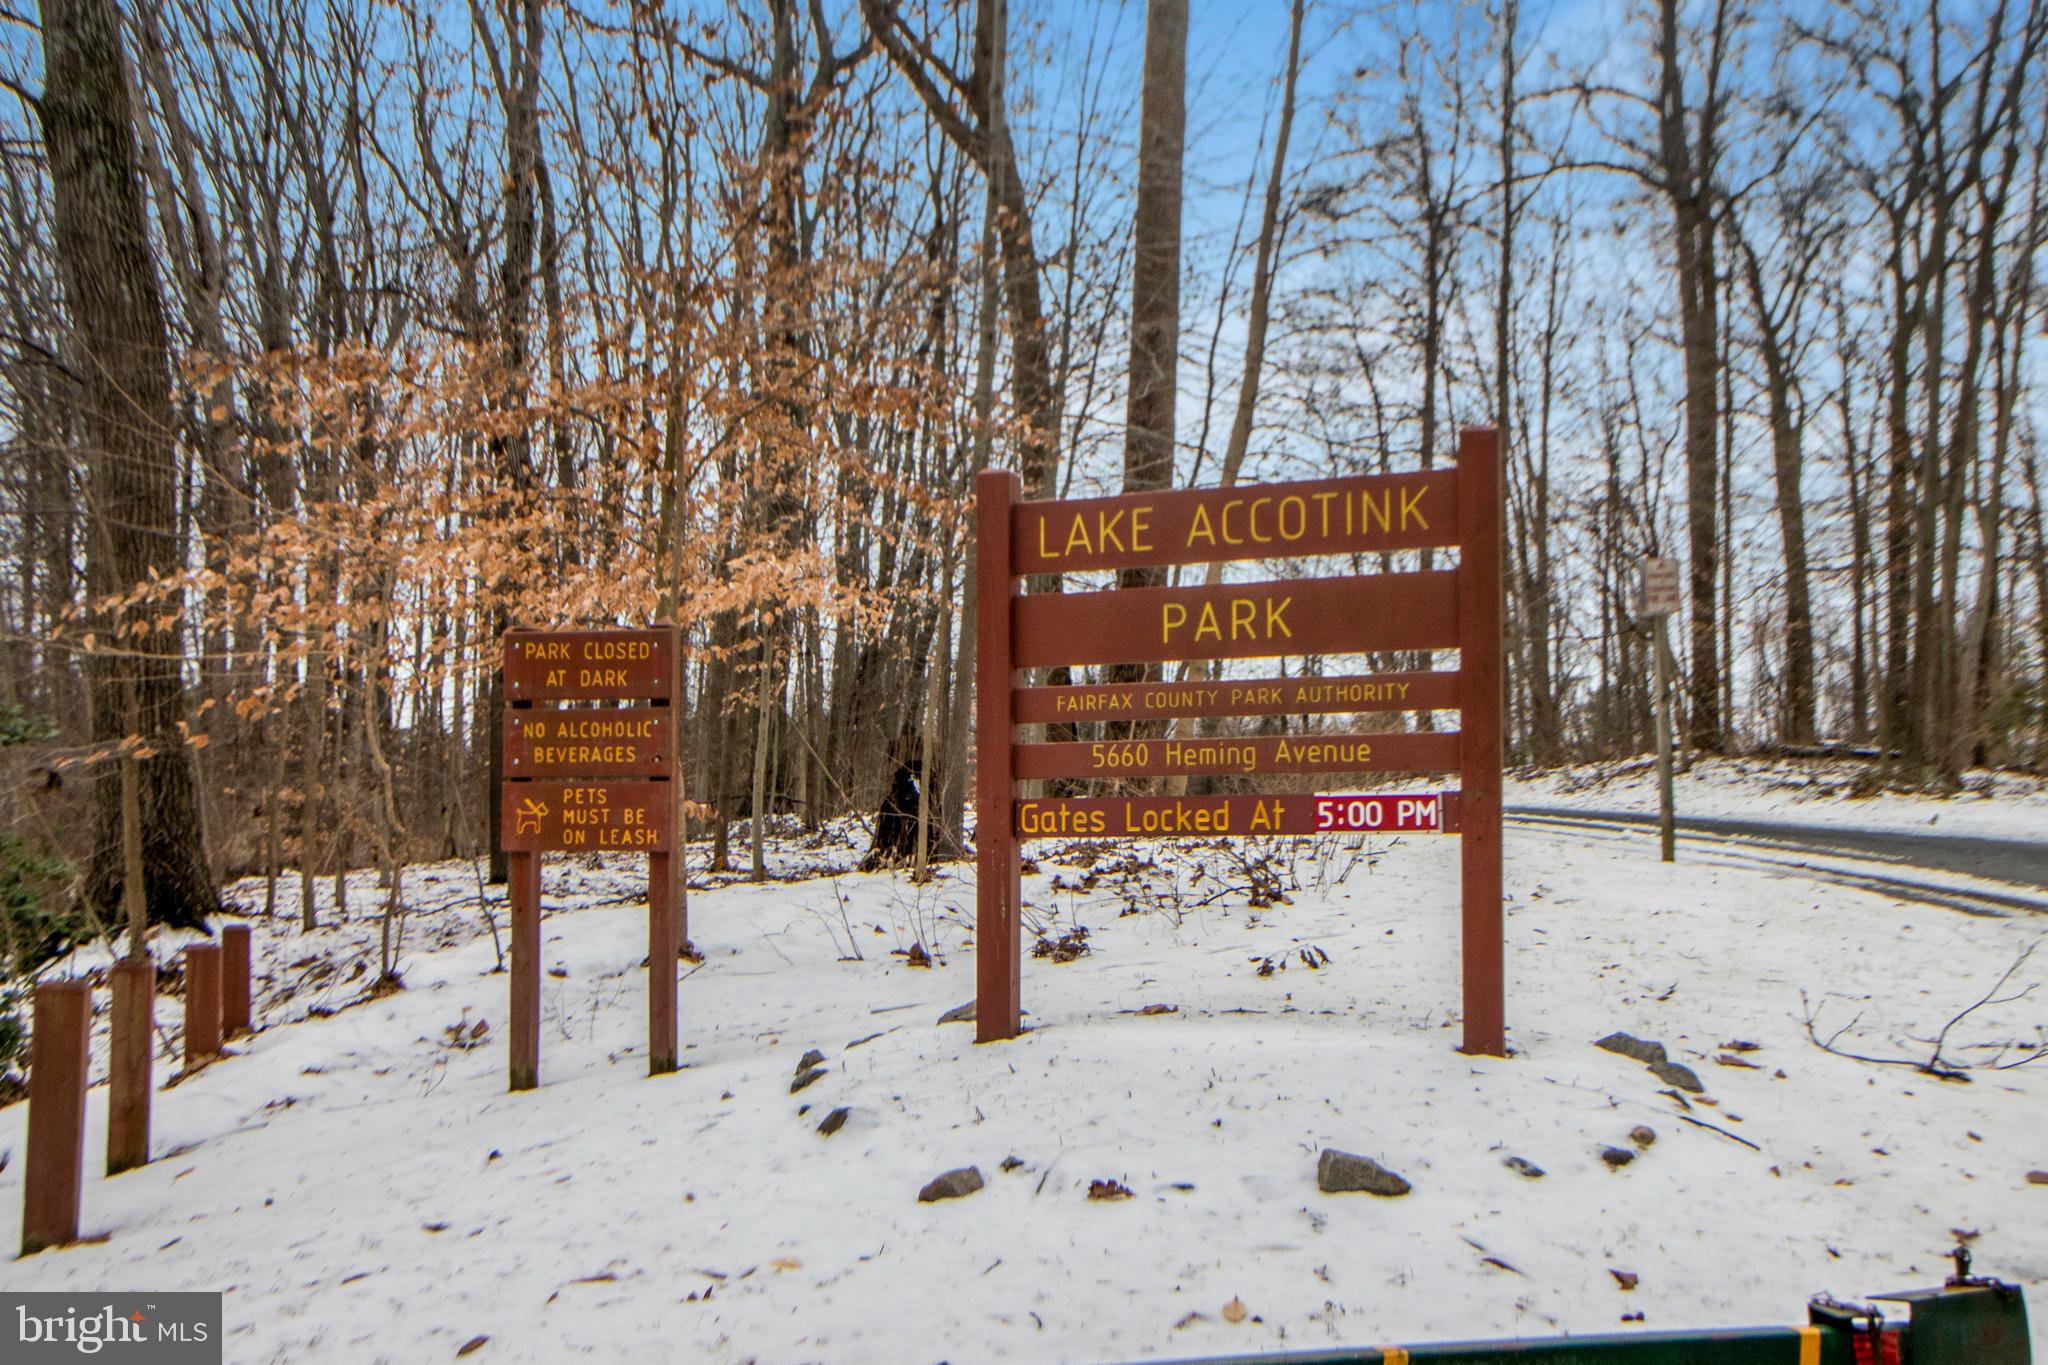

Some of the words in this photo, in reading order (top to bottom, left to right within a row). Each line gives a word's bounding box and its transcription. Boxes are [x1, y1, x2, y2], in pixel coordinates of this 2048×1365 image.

[1039, 507, 1153, 559] LAKE
[1187, 485, 1429, 548] ACCOTINK
[1162, 596, 1293, 644] PARK
[525, 643, 570, 659] PARK
[584, 642, 649, 659] CLOSED
[546, 670, 566, 687] AT
[580, 670, 628, 687] DARK
[1056, 693, 1133, 712] FAIRFAX
[1145, 690, 1217, 709] COUNTY
[1231, 687, 1282, 705] PARK
[1296, 682, 1410, 701] AUTHORITY
[524, 722, 545, 738] NO
[557, 721, 651, 738] ALCOHOLIC
[534, 747, 636, 763] BEVERAGES
[1092, 743, 1149, 769] 5660
[1166, 742, 1257, 772] Heming
[1275, 739, 1372, 763] Avenue
[563, 789, 607, 804] PETS
[563, 809, 609, 824] MUST
[624, 809, 645, 824] BE
[1021, 803, 1106, 833] Gates
[1125, 800, 1229, 832] Locked
[1250, 800, 1285, 831] At
[1317, 800, 1383, 828] 5:00
[1398, 799, 1437, 827] PM
[563, 829, 585, 844] ON
[600, 829, 657, 844] LEASH
